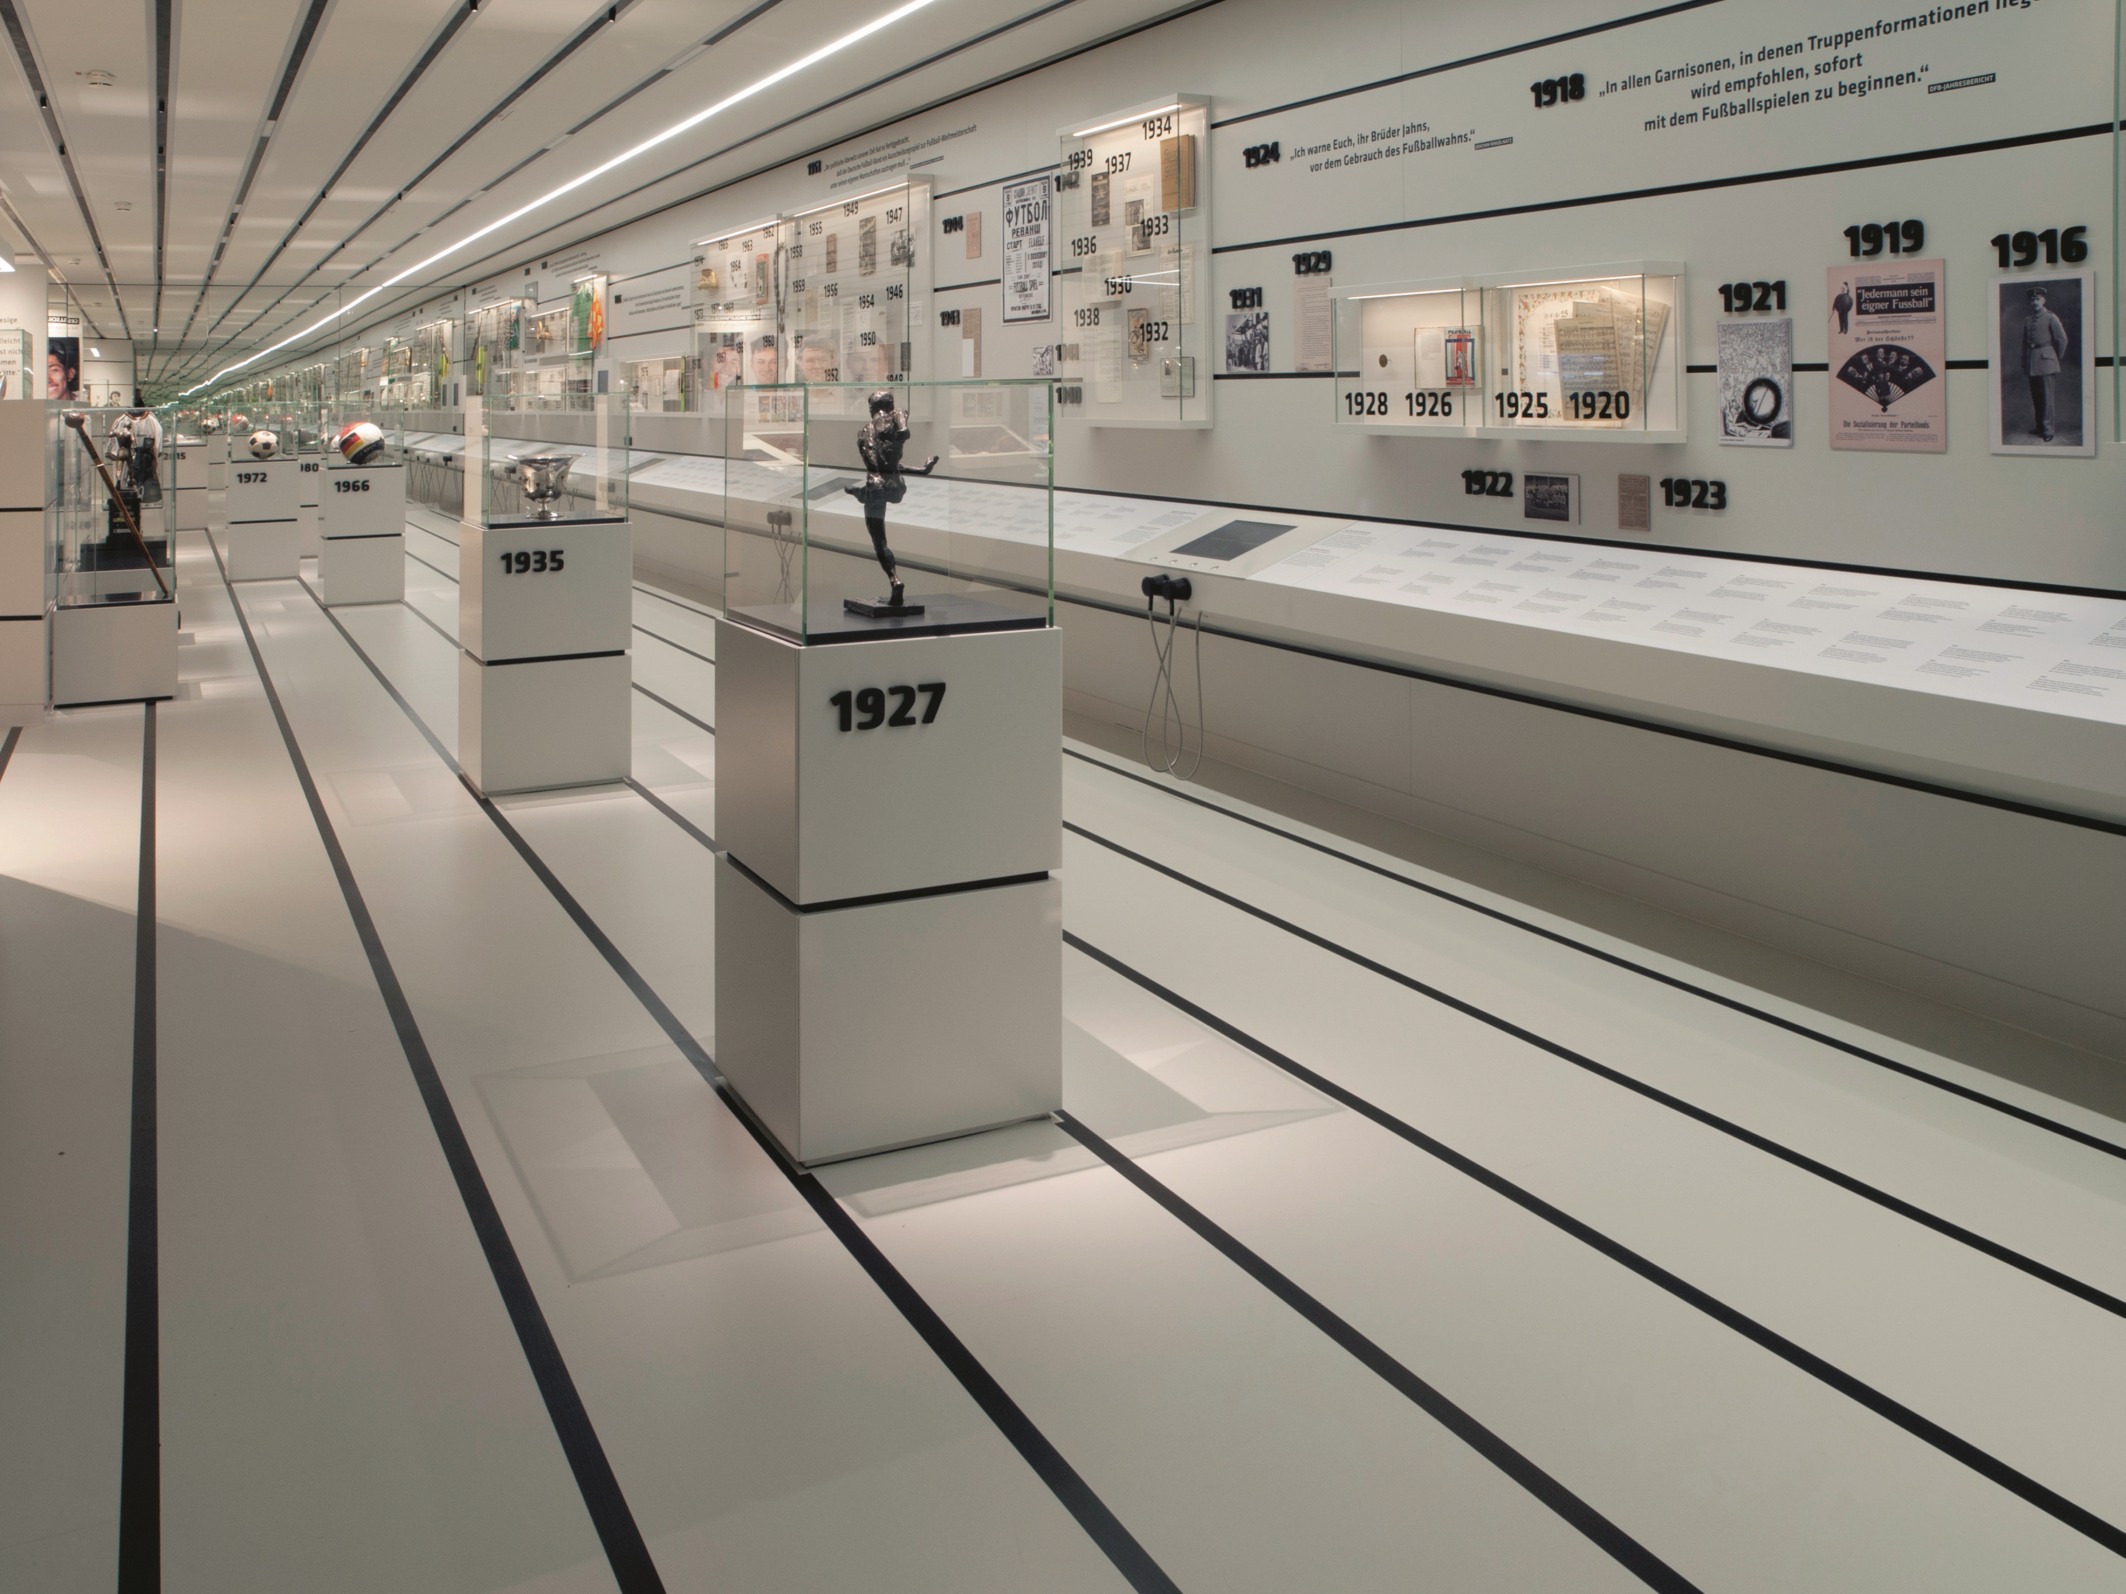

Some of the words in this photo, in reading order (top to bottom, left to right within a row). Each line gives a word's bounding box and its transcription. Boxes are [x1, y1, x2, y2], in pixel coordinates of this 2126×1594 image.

[1599, 80, 1618, 98] „In
[1621, 75, 1651, 92] allen
[1655, 57, 1735, 84] Garnisonen,
[1740, 50, 1753, 67] in
[1757, 41, 1804, 62] denen
[1808, 0, 1989, 51] Truppenformationen
[1691, 79, 1721, 99] wird
[1724, 65, 1809, 94] empfohlen,
[1814, 53, 1863, 76] sofort
[1928, 73, 1996, 94] DFB-JAHRESBERICHT
[1530, 73, 1585, 108] 1918
[1644, 115, 1666, 131] mit
[1669, 112, 1698, 127] dem
[1702, 90, 1810, 121] Fußballspielen
[1815, 87, 1833, 101] zu
[1838, 64, 1929, 97] beginnen.“
[1142, 116, 1172, 140] 1934
[1307, 143, 1331, 156] warne
[1333, 136, 1356, 150] Euch,
[1357, 133, 1370, 145] ihr
[1371, 127, 1401, 143] Brüder
[1402, 122, 1430, 138] Jahns,
[1068, 149, 1093, 171] 1939
[1105, 152, 1131, 175] 1937
[1243, 141, 1281, 168] 1924
[1309, 162, 1323, 173] vor
[1325, 158, 1342, 170] dem
[1344, 148, 1383, 167] Gebrauch
[1385, 145, 1401, 158] des
[843, 201, 859, 217] 1949
[886, 207, 903, 225] 1947
[1005, 200, 1047, 228] ФУТБОЛ
[809, 221, 823, 236] 1955
[1011, 223, 1041, 239] РЕВАНШ
[1140, 215, 1169, 238] 1933
[1843, 219, 1925, 257] 1919
[1006, 240, 1022, 250] СТАРТ
[1071, 236, 1097, 257] 1936
[1990, 225, 2088, 268] 1916
[1292, 250, 1332, 276] 1929
[886, 284, 903, 300] 1946
[1105, 275, 1132, 296] 1930
[1718, 280, 1786, 313] 1921
[1910, 286, 1929, 297] sein
[858, 294, 875, 309] 1954
[1229, 286, 1263, 309] 1931
[1861, 301, 1889, 313] eigner
[1074, 308, 1100, 327] 1938
[860, 331, 876, 347] 1950
[1139, 322, 1169, 342] 1932
[1345, 392, 1389, 417] 1928
[1405, 391, 1453, 418] 1926
[1495, 392, 1548, 418] 1925
[1569, 391, 1630, 419] 1920
[237, 472, 268, 484] 1972
[335, 479, 370, 493] 1966
[1461, 469, 1514, 498] 1922
[1660, 478, 1727, 510] 1923
[500, 549, 565, 574] 1935
[829, 682, 946, 733] 1927
